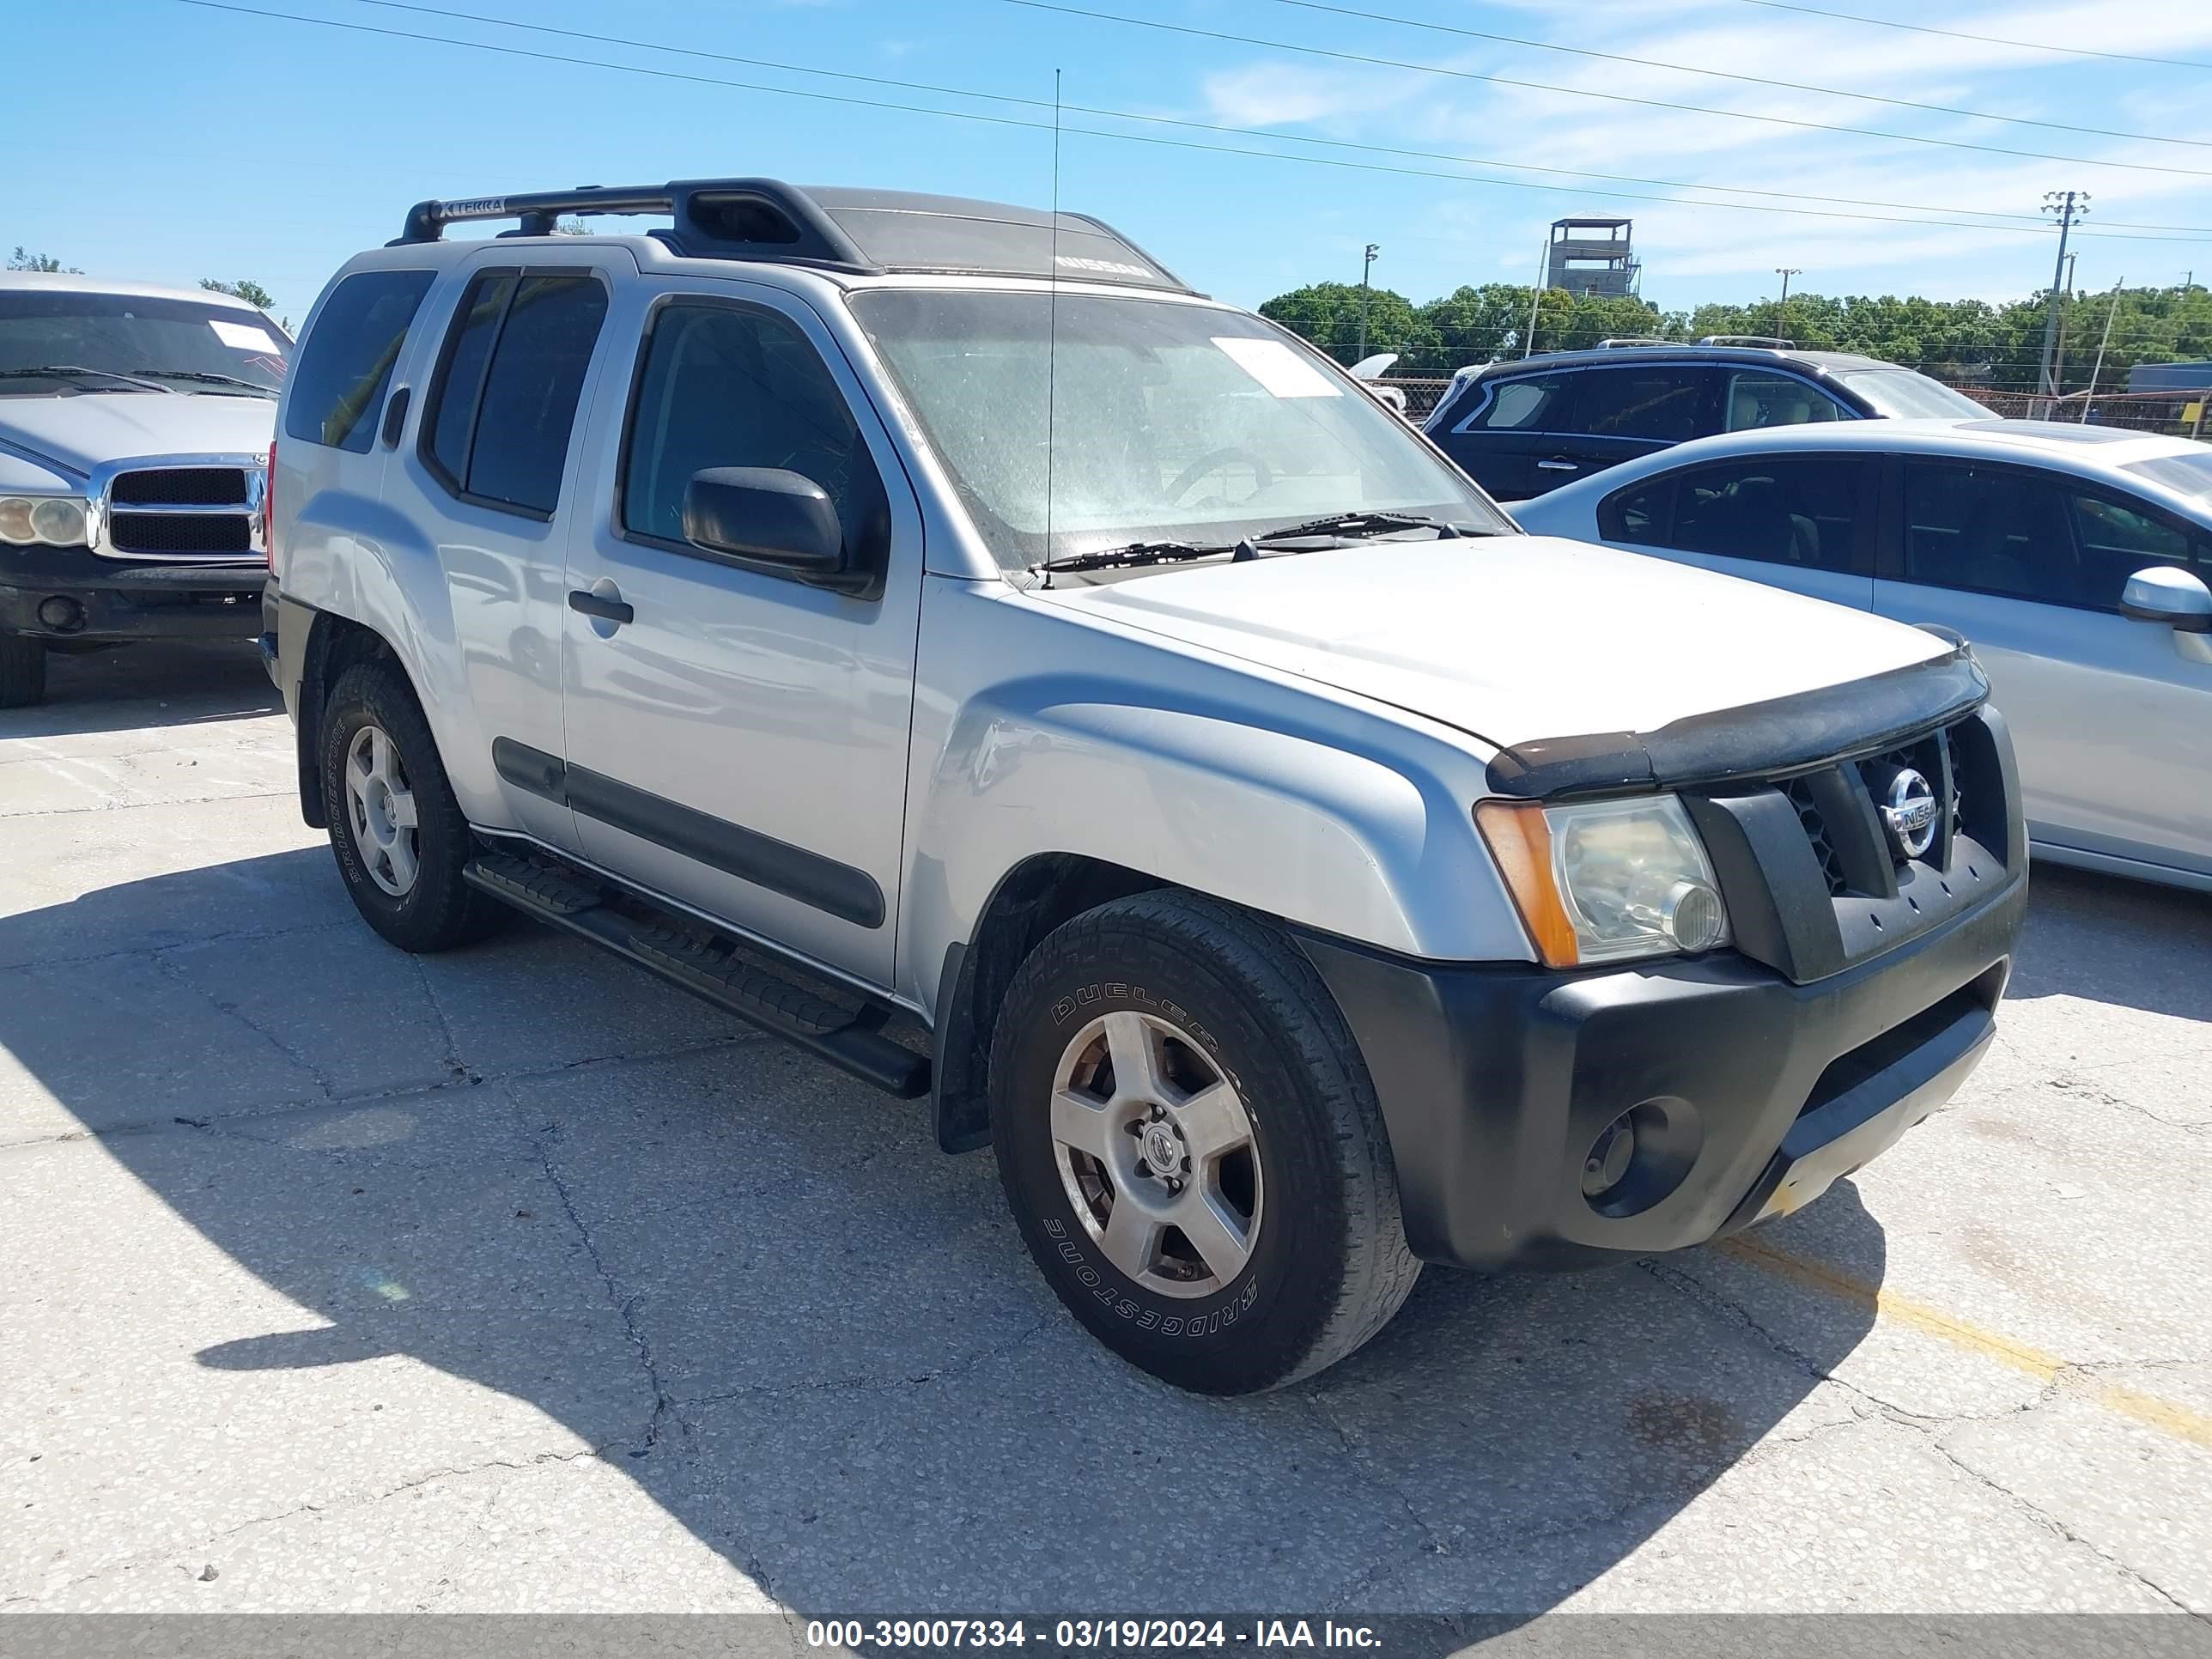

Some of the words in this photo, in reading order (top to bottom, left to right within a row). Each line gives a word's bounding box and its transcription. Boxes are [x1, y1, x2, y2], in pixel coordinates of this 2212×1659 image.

[1055, 255, 1154, 279] NISSAN
[328, 719, 362, 884] BRIDGESTONE
[1050, 982, 1219, 1053] DUELER
[1043, 1218, 1259, 1336] BRIDGESTONE
